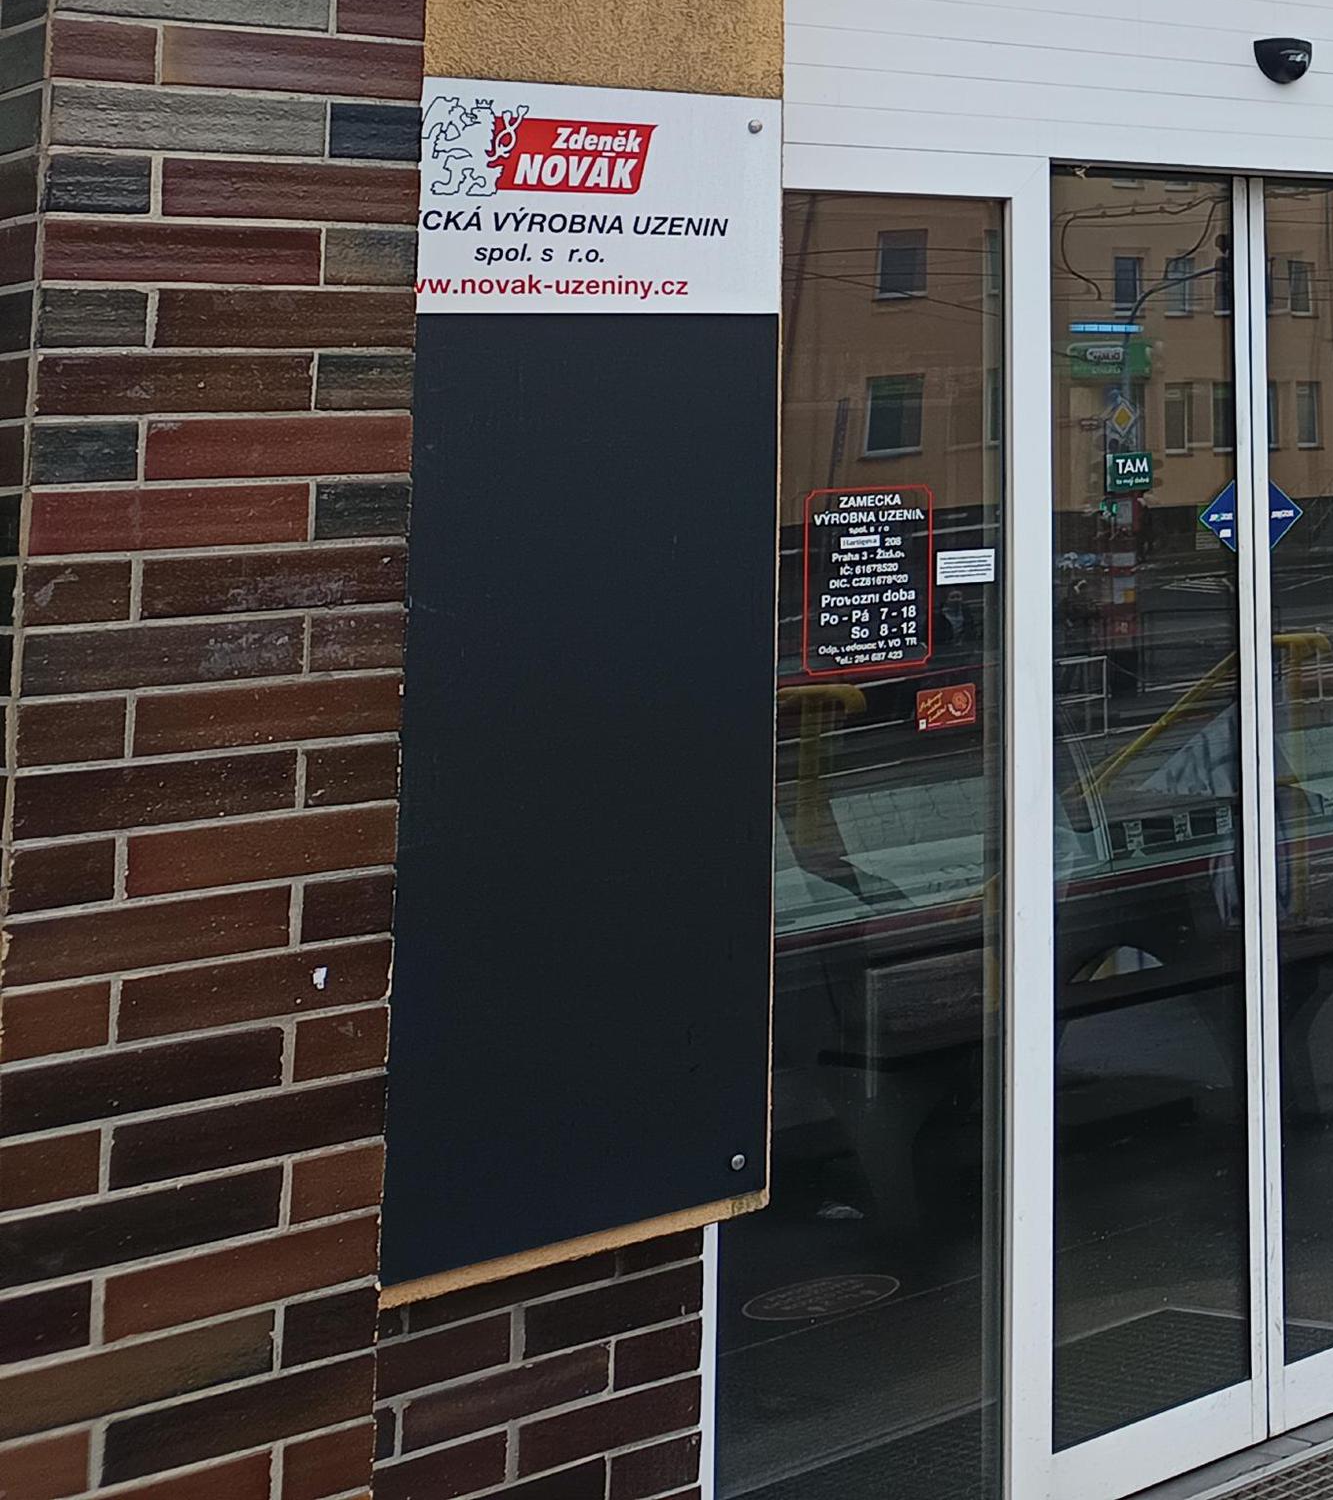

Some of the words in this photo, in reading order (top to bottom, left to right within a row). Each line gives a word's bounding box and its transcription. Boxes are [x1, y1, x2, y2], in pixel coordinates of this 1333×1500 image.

[552, 126, 642, 155] Zdeněk
[513, 151, 640, 189] NOVÁK
[418, 206, 482, 231] CKÁ
[494, 207, 624, 235] VÝROBNA
[633, 216, 728, 238] UZENIN
[474, 243, 533, 266] spol.
[541, 246, 554, 262] s
[568, 247, 606, 263] r.o.
[1116, 457, 1149, 474] TAM
[883, 589, 916, 602] doba
[820, 613, 839, 626] Po
[851, 609, 869, 623] Pá
[880, 608, 888, 620] 7
[901, 605, 916, 618] 18
[851, 626, 869, 639] So
[880, 624, 888, 636] 8
[901, 621, 916, 634] 12
